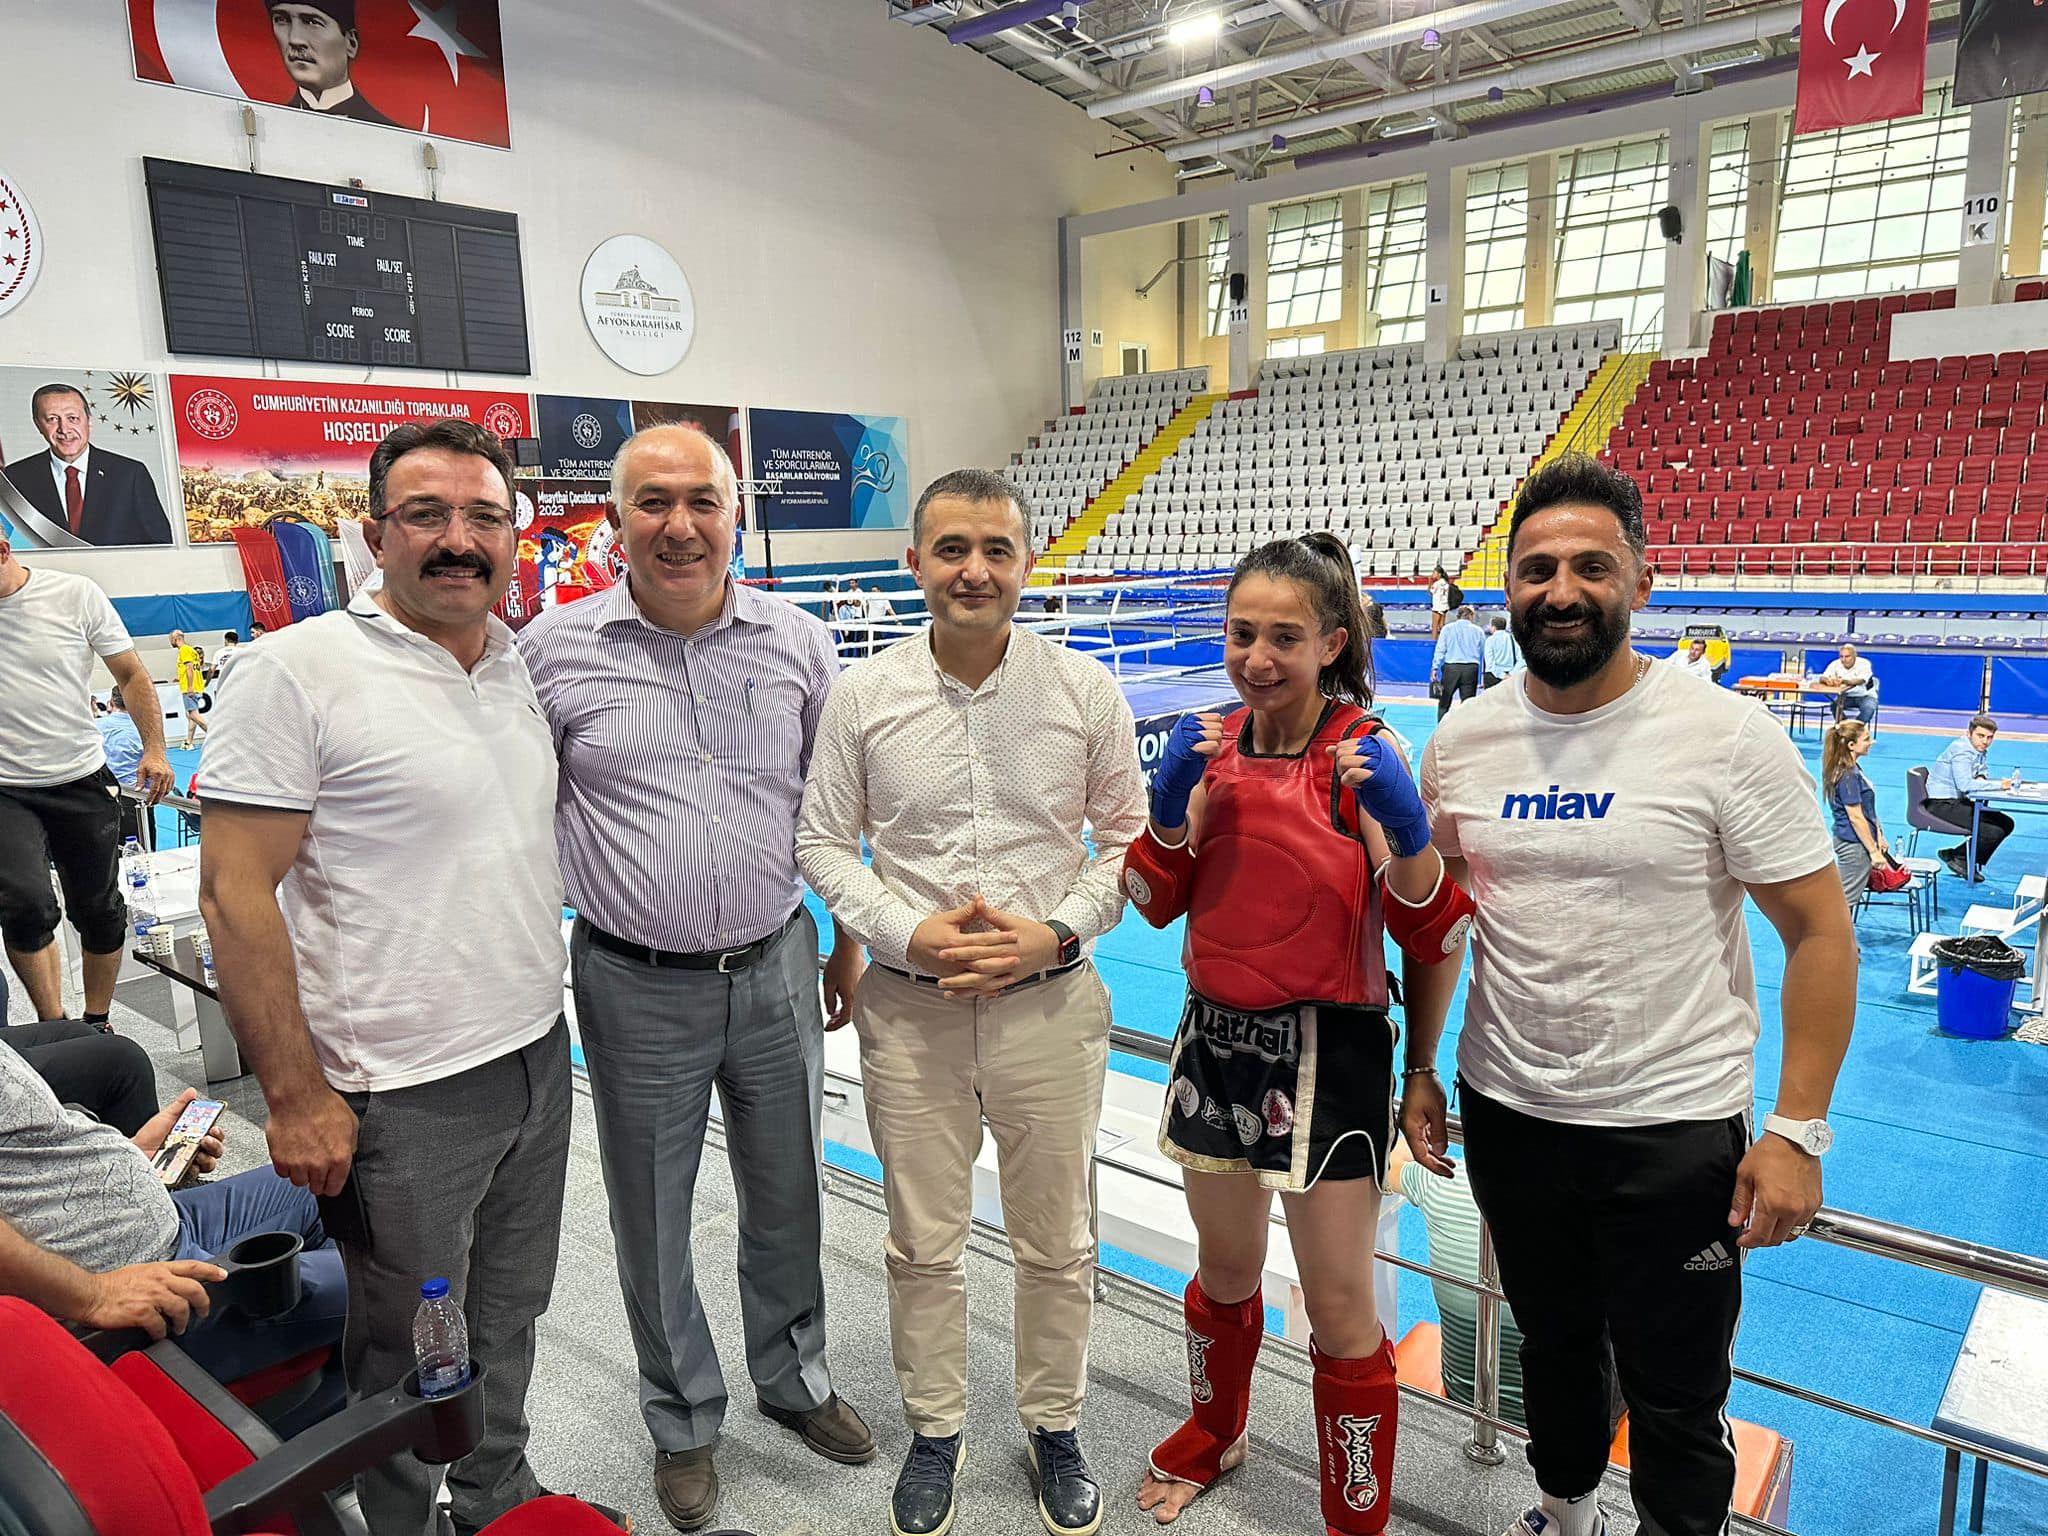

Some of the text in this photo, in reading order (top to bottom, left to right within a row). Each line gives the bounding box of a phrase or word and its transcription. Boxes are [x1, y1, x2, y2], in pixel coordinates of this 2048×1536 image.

[1964, 198, 1998, 215] 110
[1968, 222, 1988, 241] K
[346, 235, 365, 248] TIME
[1431, 288, 1441, 303] L
[351, 306, 374, 318] PERIOD
[1230, 308, 1247, 322] 111
[326, 323, 355, 339] SCORE
[384, 327, 411, 344] SCORE
[1066, 331, 1081, 344] 112
[1092, 332, 1102, 345] M
[1069, 348, 1080, 361] M
[252, 394, 470, 418] CUMHURİYETİN KAZANILDIĞI TOPRAKLARA
[323, 420, 407, 445] HOŞGELDİ
[771, 447, 832, 461] TÜM ANTRENÖR
[558, 458, 613, 470] TÜM ANTREN
[763, 460, 841, 471] VE SPORCULARIMIZA
[550, 469, 560, 477] VE
[538, 504, 565, 517] 2023
[1501, 785, 1615, 820] miav
[1683, 1257, 1733, 1271] adidas
[1339, 1416, 1379, 1483] DRAGON
